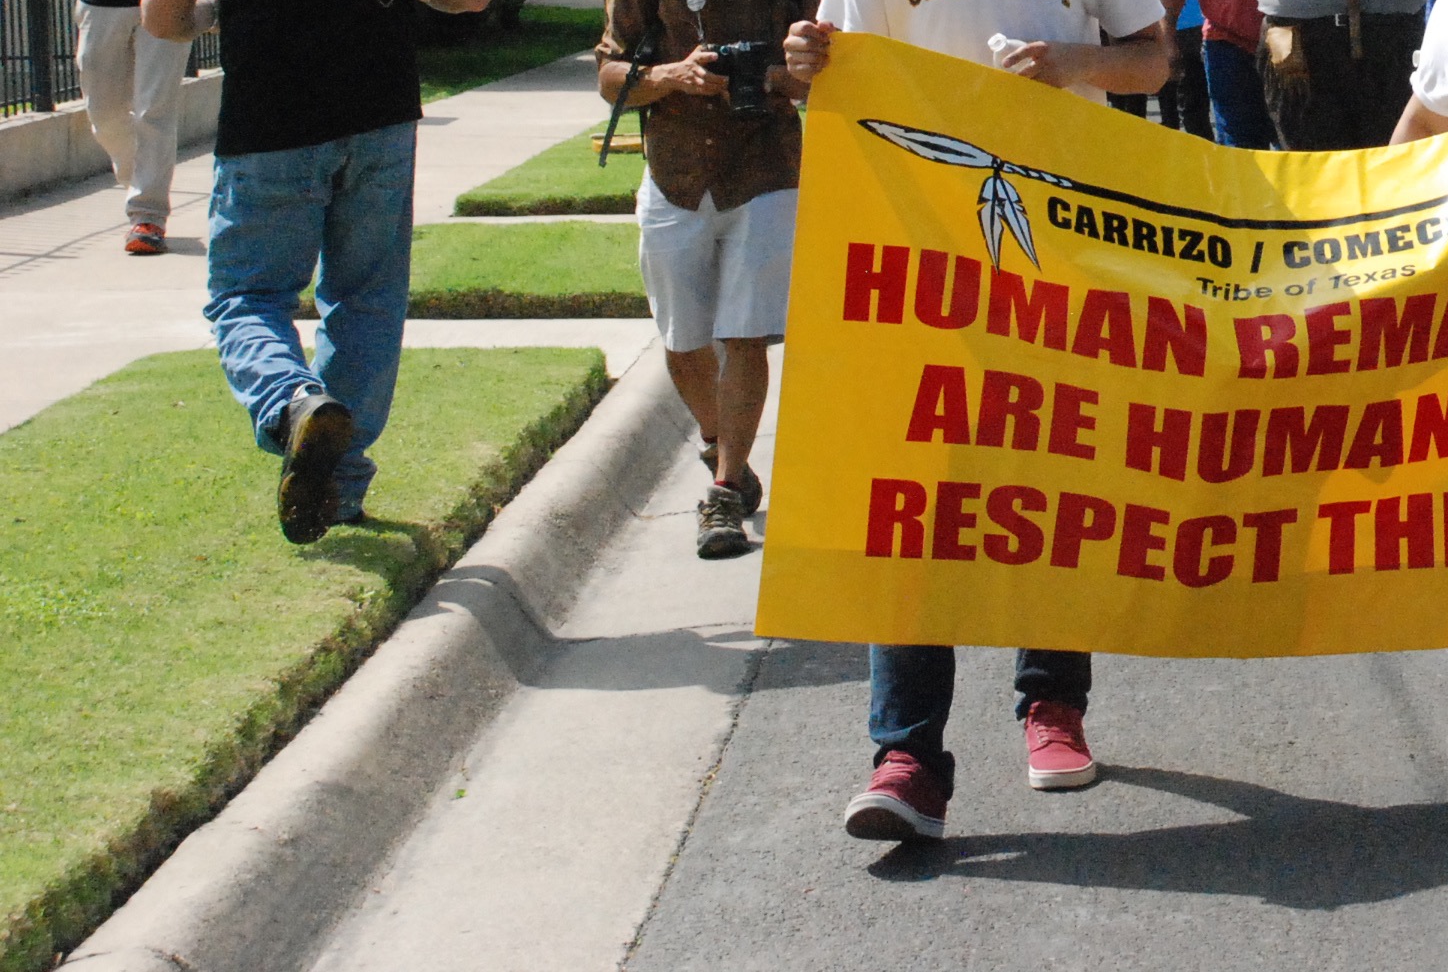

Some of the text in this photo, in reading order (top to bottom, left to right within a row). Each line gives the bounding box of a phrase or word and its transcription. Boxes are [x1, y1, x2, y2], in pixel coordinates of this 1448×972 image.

[1047, 196, 1232, 268] CARRIZO
[842, 243, 1207, 377] HUMAN
[1196, 263, 1416, 302] Tribe of Texas
[906, 365, 1099, 460] ARE
[865, 477, 1297, 588] RESPECT
